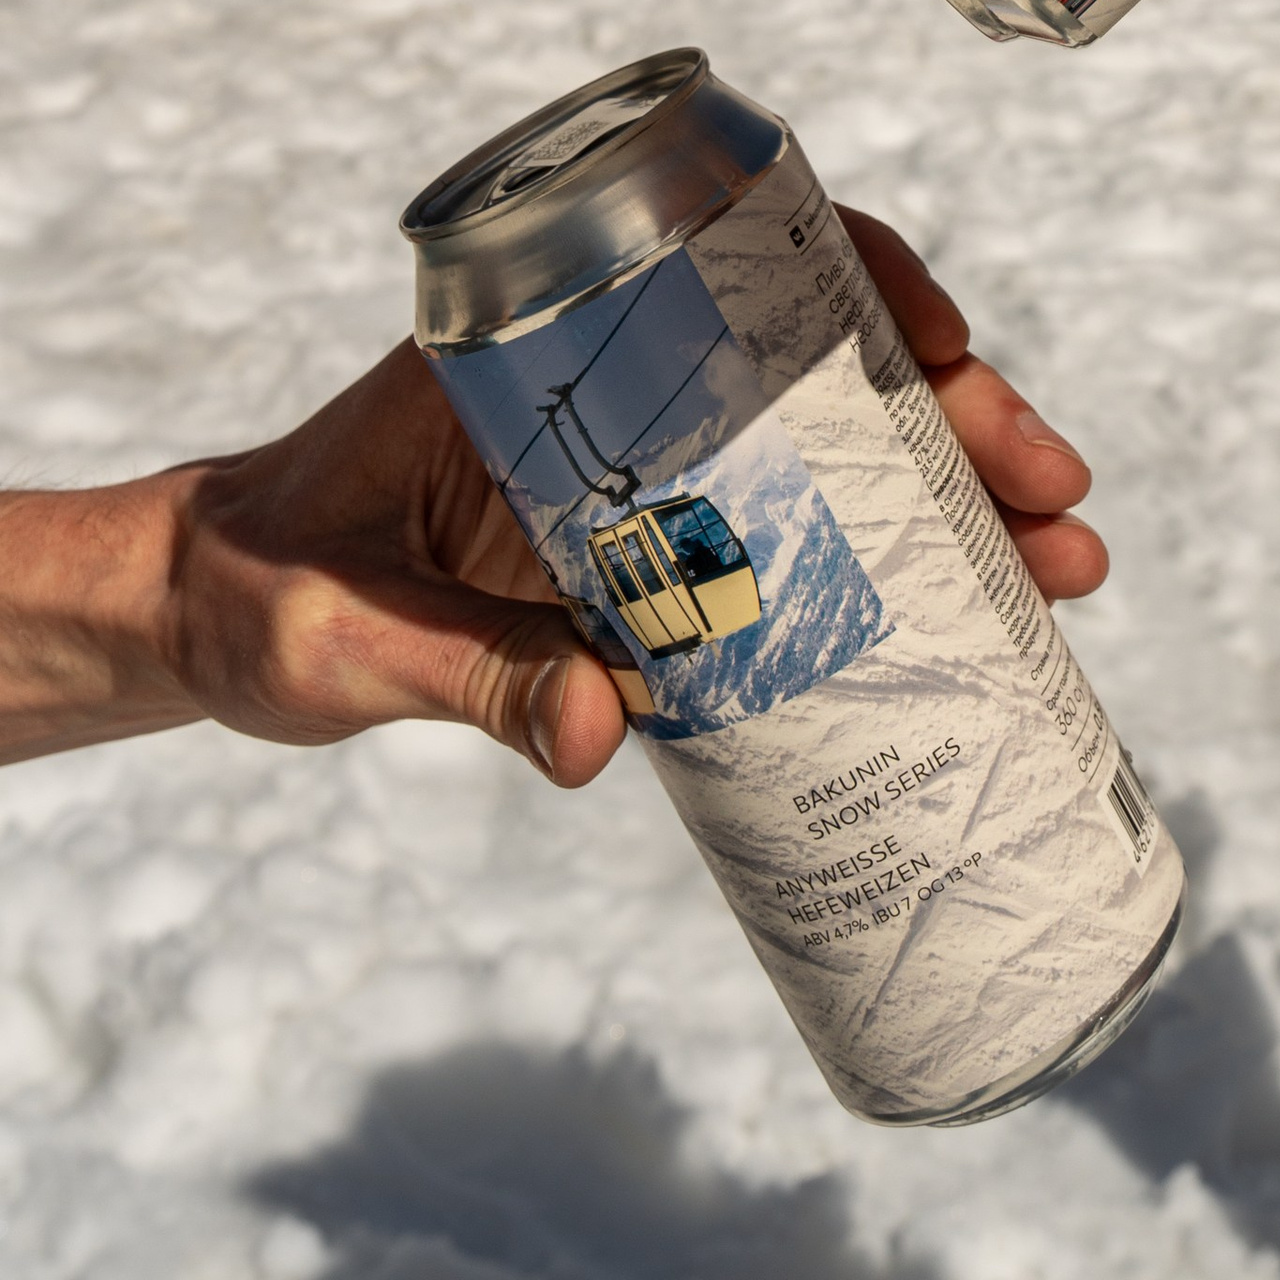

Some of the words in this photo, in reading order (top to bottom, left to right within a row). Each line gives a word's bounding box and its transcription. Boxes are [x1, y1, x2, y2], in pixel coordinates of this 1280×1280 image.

[815, 256, 845, 295] Пиво
[888, 408, 898, 421] по
[943, 497, 962, 524] После
[1030, 650, 1049, 681] Страна
[1045, 687, 1061, 711] Срок
[1054, 696, 1077, 735] 360
[1077, 731, 1100, 772] Объем
[793, 745, 900, 813] BAKUNIN
[808, 792, 880, 840] SNOW
[885, 737, 960, 800] SERIES
[776, 835, 901, 898] ANYWEISSE
[788, 853, 931, 924] HEFEWEIZEN
[804, 931, 830, 947] ABV
[834, 918, 869, 939] 4,7%
[872, 903, 901, 925] IBU
[900, 897, 910, 910] 7
[918, 879, 944, 901] OG
